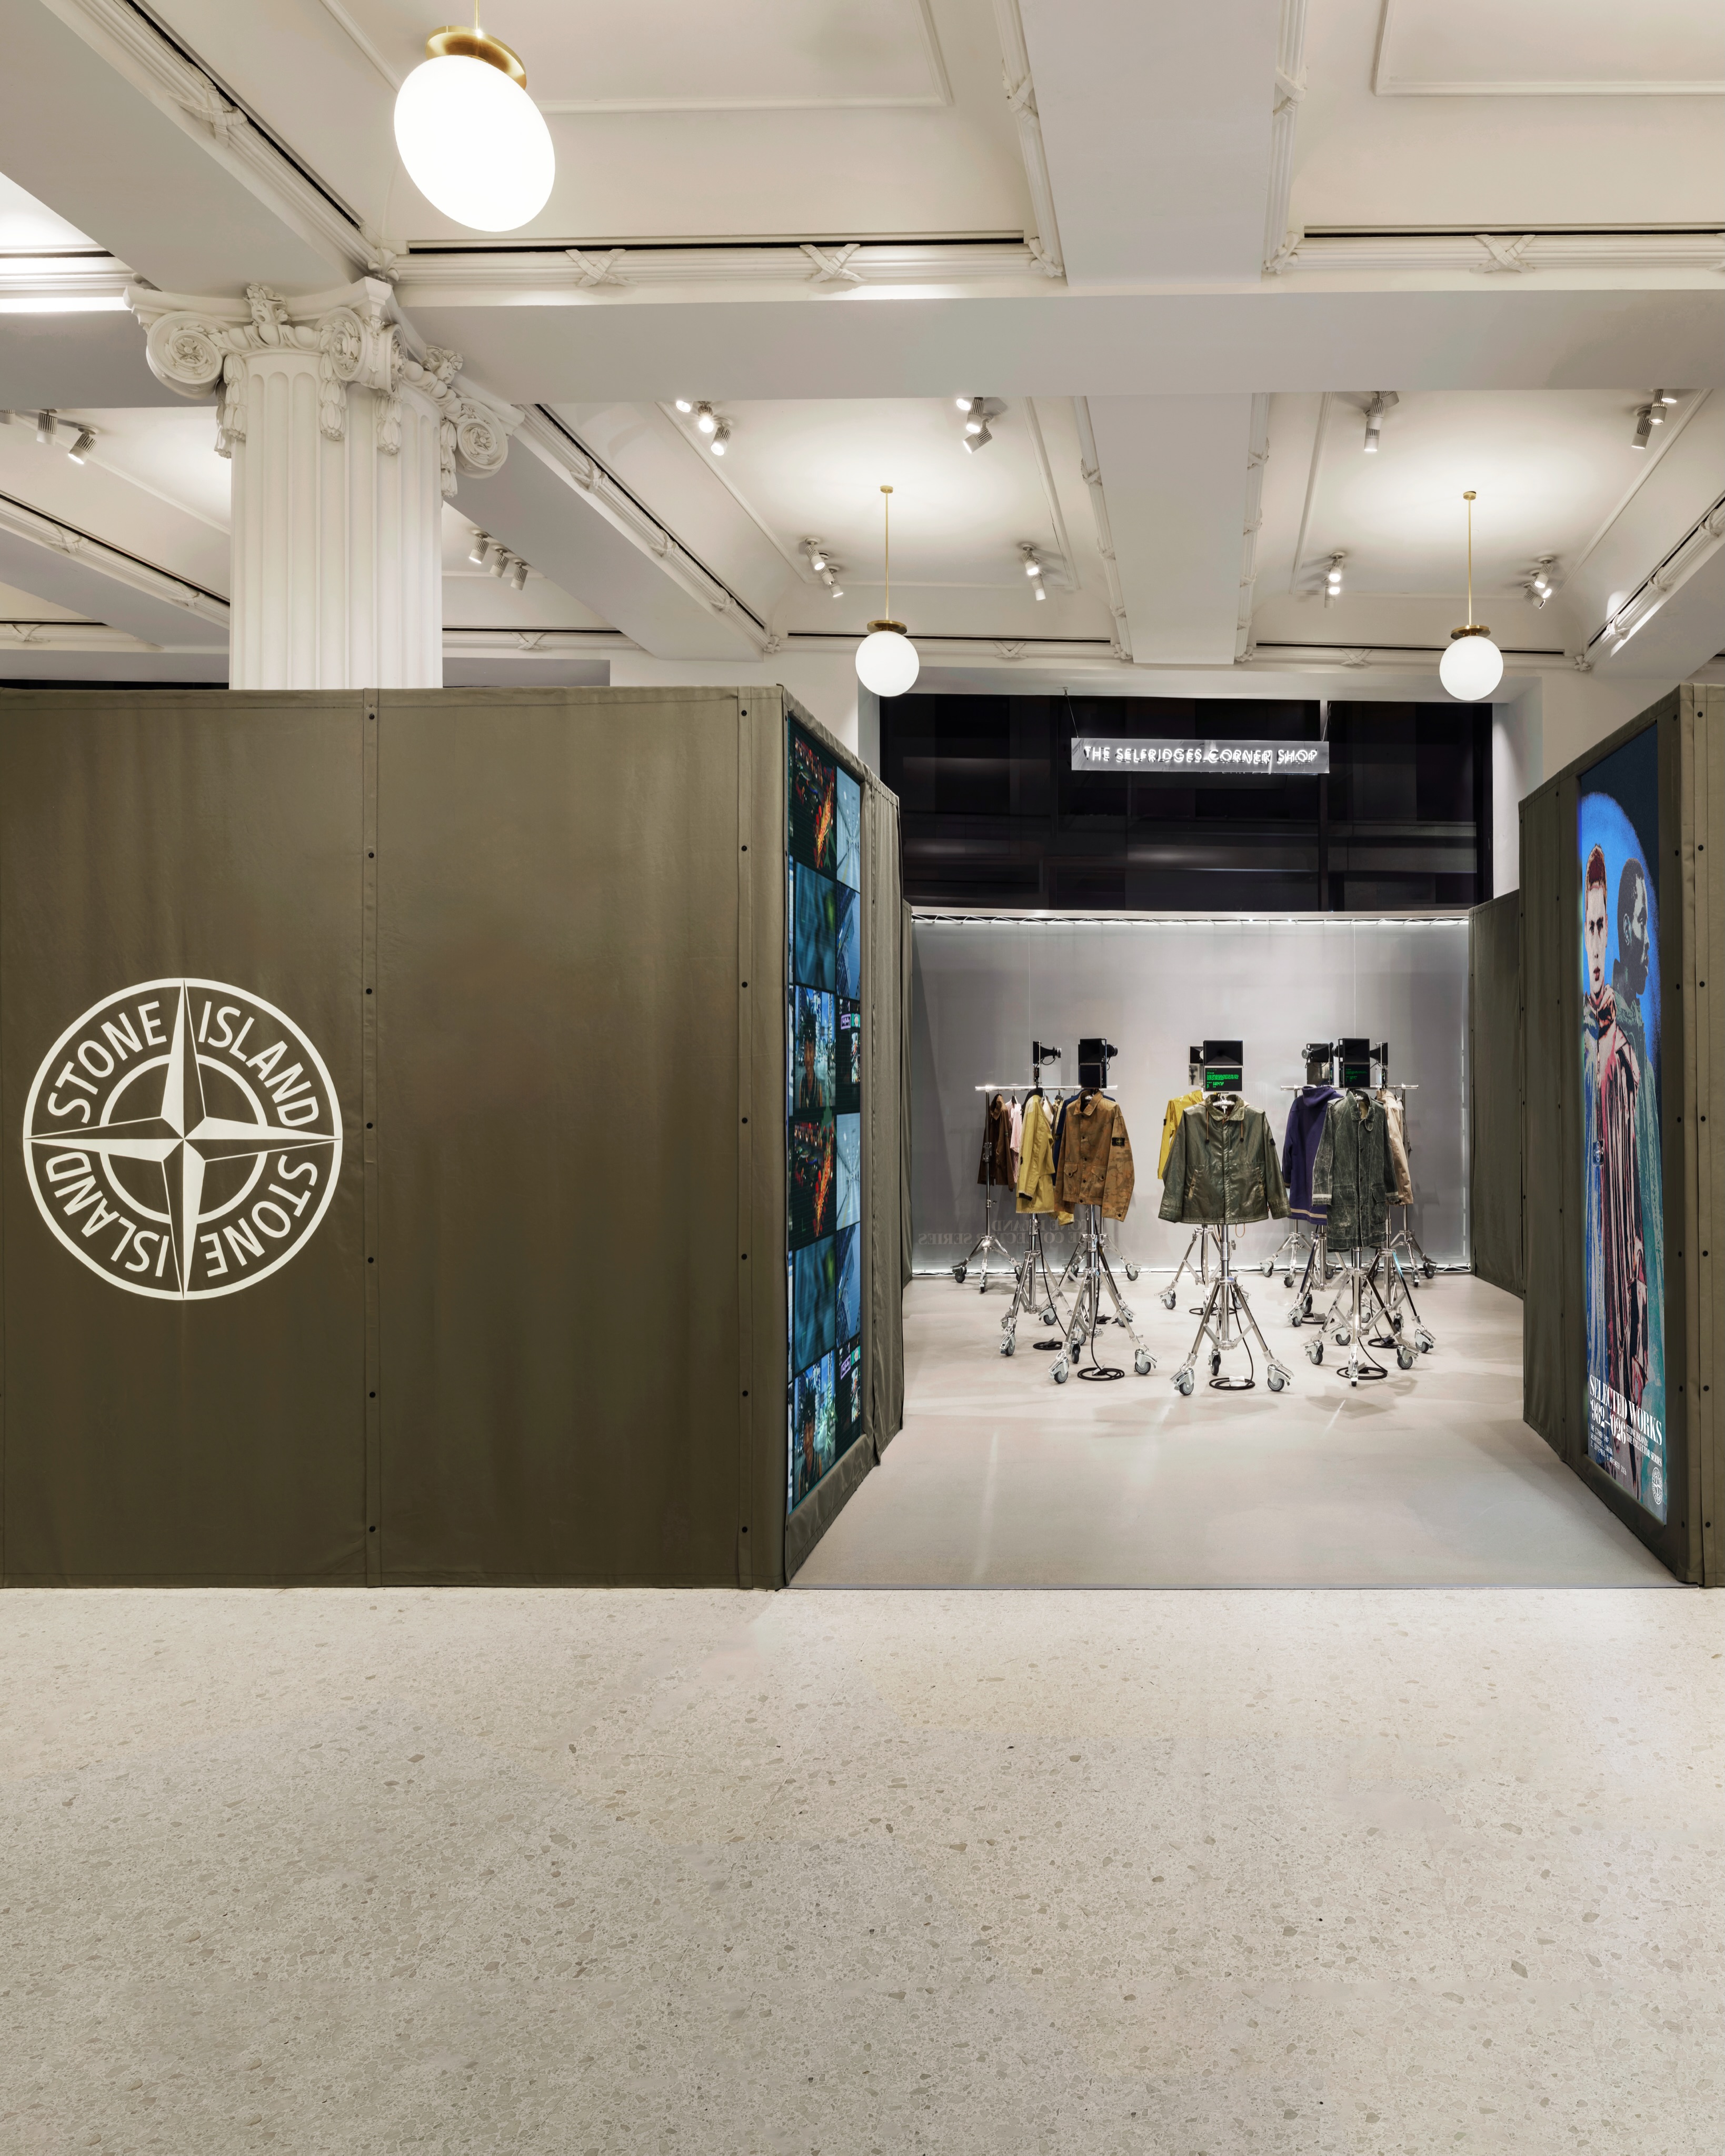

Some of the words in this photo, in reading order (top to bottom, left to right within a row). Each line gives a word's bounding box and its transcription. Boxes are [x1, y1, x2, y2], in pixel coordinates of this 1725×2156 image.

[1084, 746, 1110, 761] THE
[1116, 748, 1202, 763] SELFRIDGES
[1208, 749, 1272, 764] CORNER
[1277, 749, 1318, 764] SHOP
[47, 1001, 167, 1124] STONE
[198, 1001, 320, 1126] ISLAND
[46, 1152, 169, 1277] ISLAND
[200, 1154, 318, 1277] STONE
[1590, 1374, 1628, 1420] SELECTED
[1628, 1400, 1662, 1446] WORKS
[1626, 1424, 1636, 1438] STONE
[1632, 1436, 1650, 1459] COLLECTOR
[1650, 1451, 1662, 1468] SERIES
